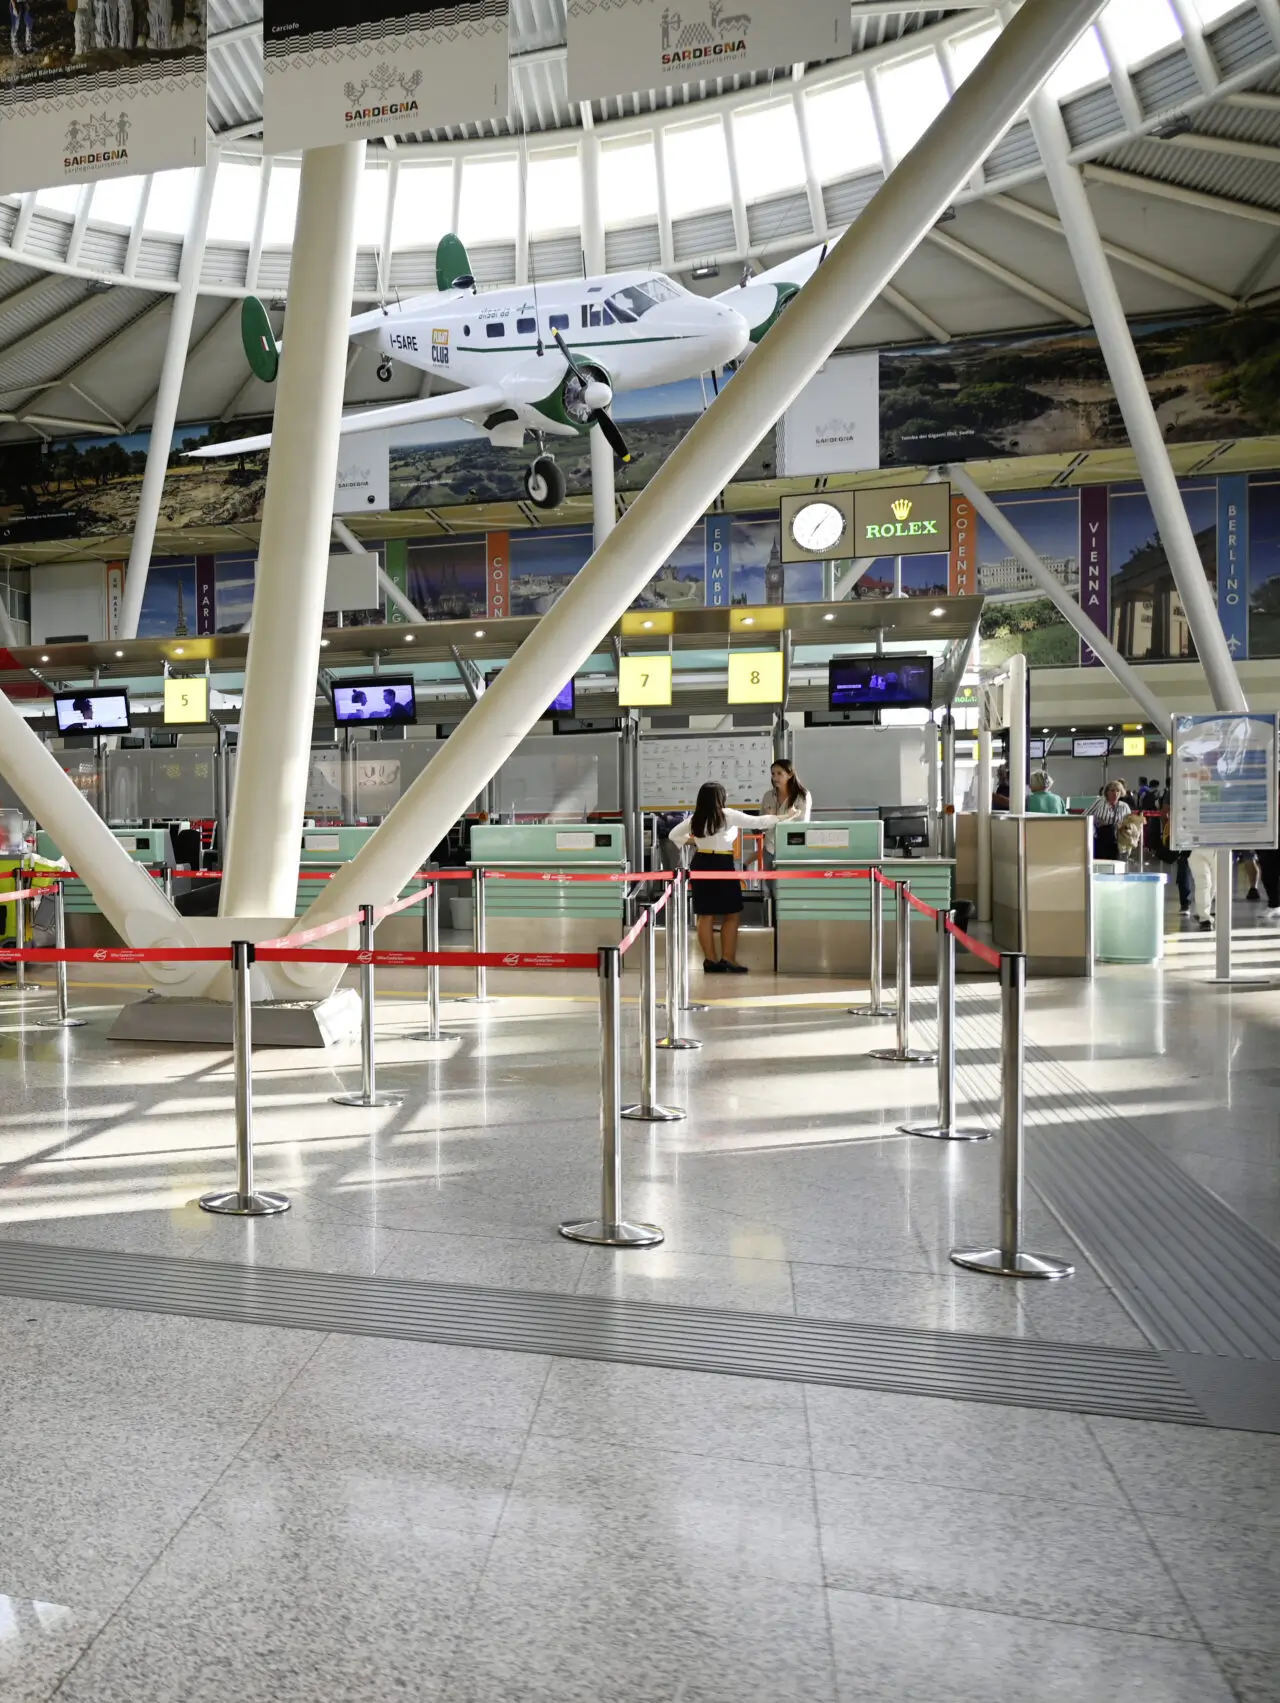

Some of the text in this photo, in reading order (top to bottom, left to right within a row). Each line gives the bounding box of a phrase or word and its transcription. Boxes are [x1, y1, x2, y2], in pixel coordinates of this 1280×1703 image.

[272, 22, 300, 33] Carciofo
[661, 40, 747, 65] SARDEGNA
[345, 100, 419, 122] SARDEGNA
[64, 149, 128, 168] SARDEGNA
[389, 333, 418, 352] I-SARE
[431, 345, 449, 364] CLUB
[865, 519, 938, 539] ROLEX
[1088, 522, 1100, 606] VIENNA
[1226, 504, 1240, 606] BERLINO
[202, 584, 210, 636] PARI
[640, 674, 650, 688] 7
[750, 671, 761, 685] 8
[181, 694, 189, 707] 5
